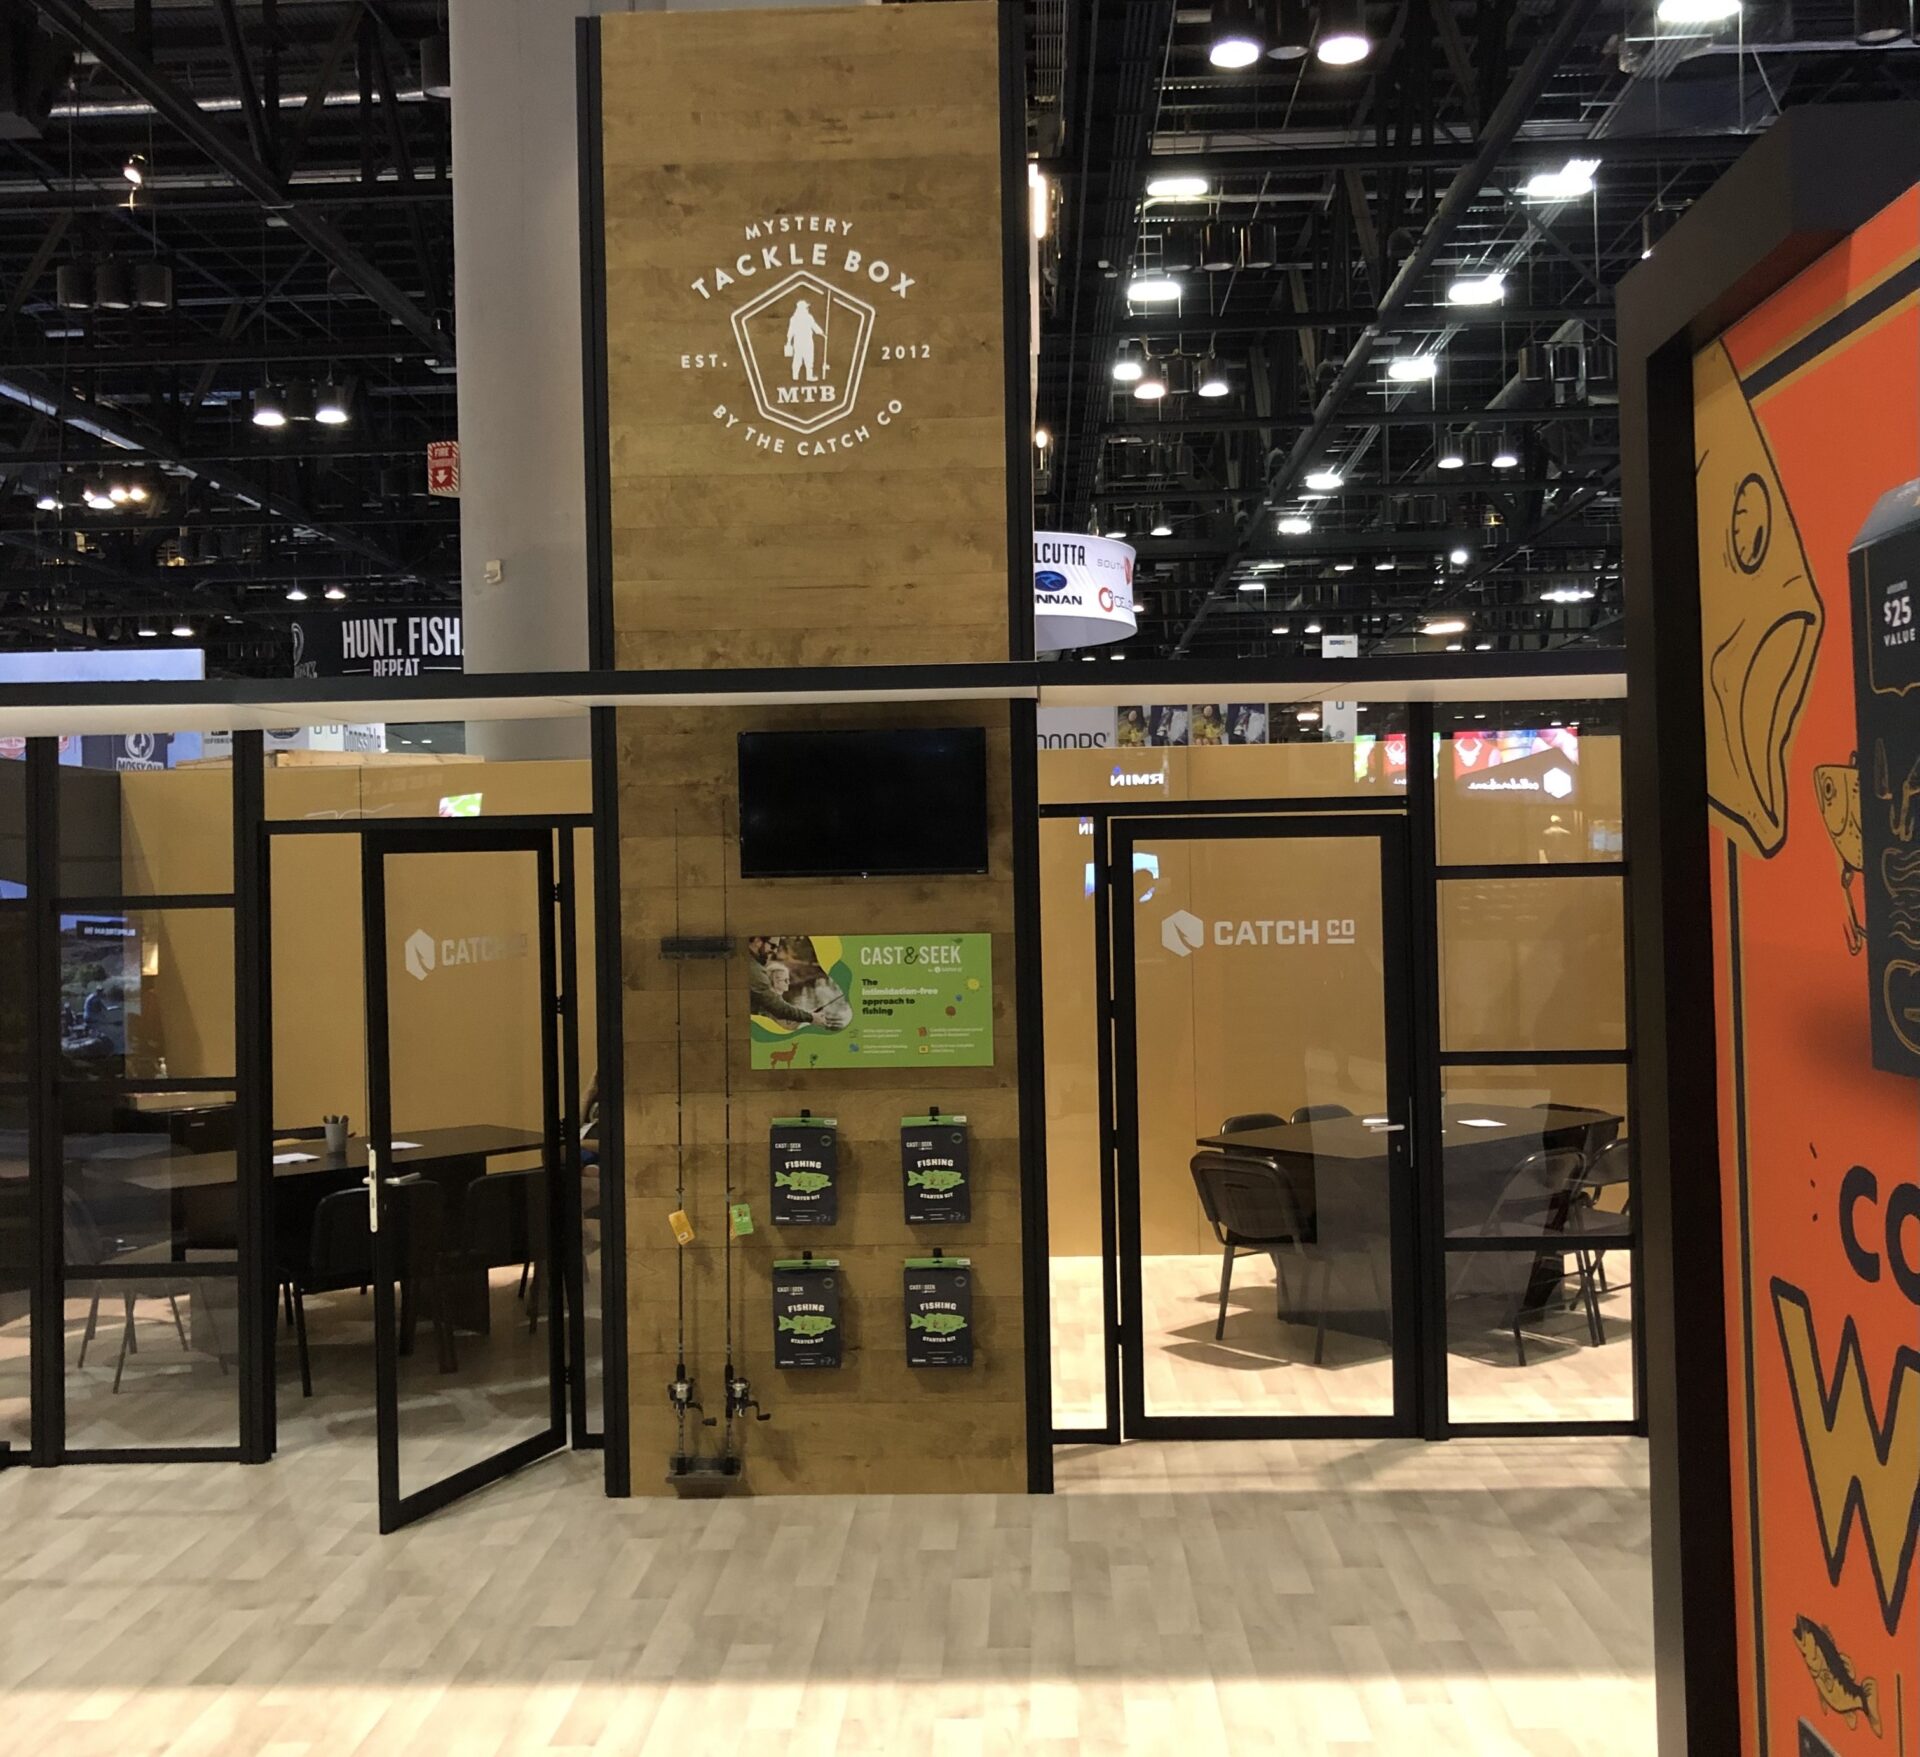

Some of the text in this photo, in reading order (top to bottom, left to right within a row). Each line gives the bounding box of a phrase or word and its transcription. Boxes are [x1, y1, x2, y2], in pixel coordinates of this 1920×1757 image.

[745, 216, 853, 240] MYSTERY
[690, 243, 915, 299] TACKLE BOX
[681, 344, 931, 368] EST. 2012
[777, 385, 836, 403] MTB
[713, 399, 903, 456] BY THE CATCH CO
[1883, 596, 1912, 627] $25
[342, 618, 402, 659] HUNT.
[1883, 628, 1916, 647] VALUE
[1214, 919, 1355, 945] CATCH CO
[862, 998, 904, 1006] approach
[862, 1008, 893, 1016] fishing
[785, 1160, 822, 1169] FISHING
[917, 1159, 954, 1168] FISHING
[788, 1304, 824, 1313] FISHING
[920, 1302, 957, 1310] FISHING
